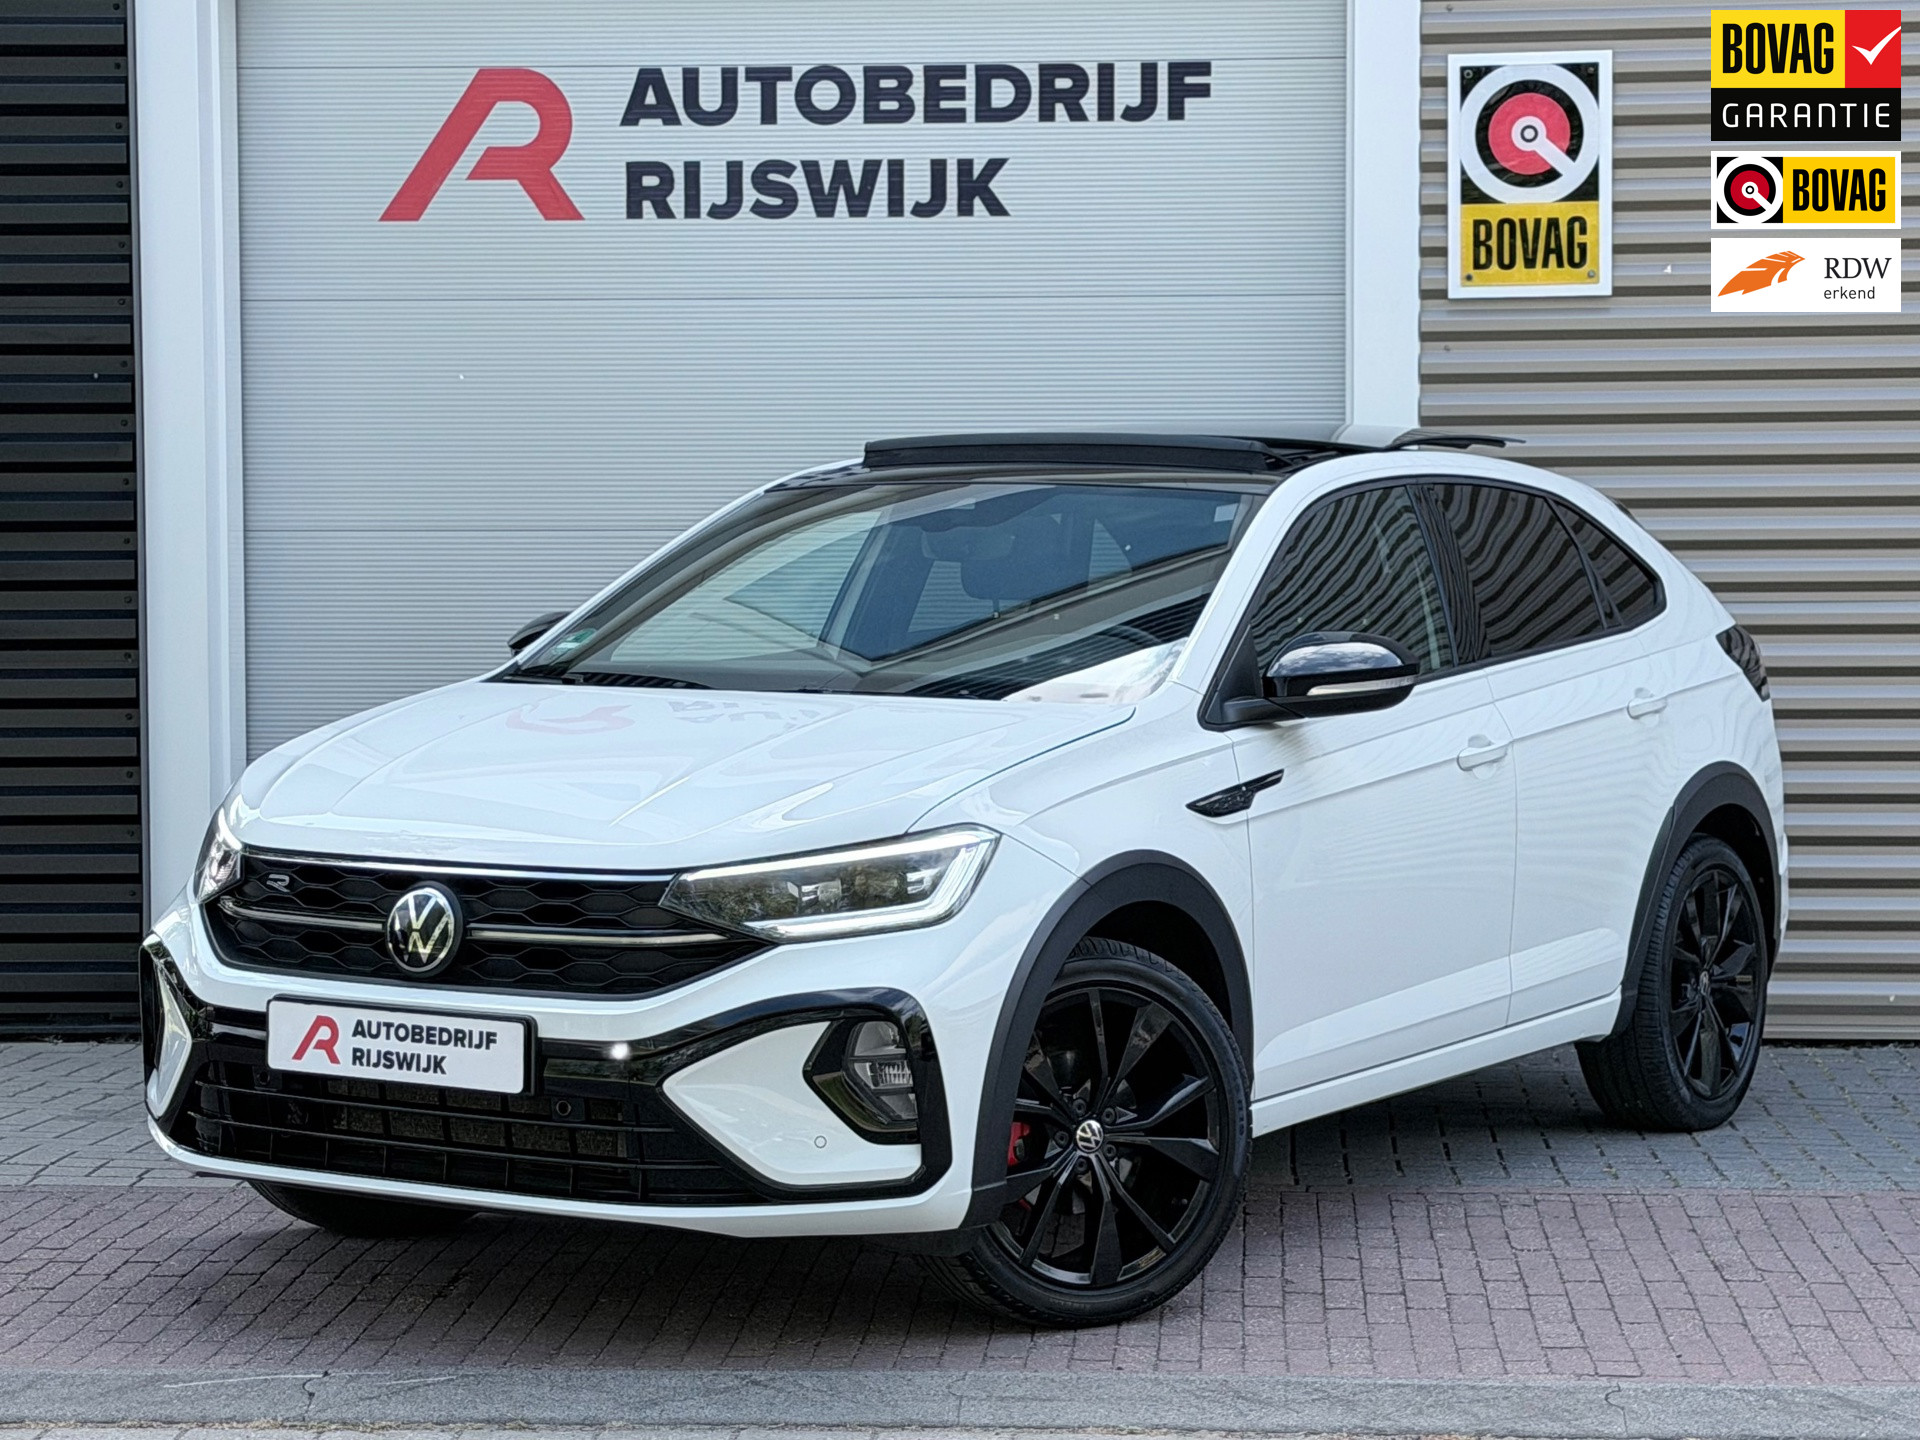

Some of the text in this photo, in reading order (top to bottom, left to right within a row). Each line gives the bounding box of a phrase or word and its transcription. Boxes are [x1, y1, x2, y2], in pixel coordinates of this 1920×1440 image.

[619, 61, 1212, 127] AUTOBEDRIJF
[625, 158, 1011, 220] RIJSWIJK
[1472, 216, 1587, 270] BOVAG
[352, 1019, 497, 1050] AUTOBEDRIJF
[352, 1047, 447, 1074] RIJSWIJK
